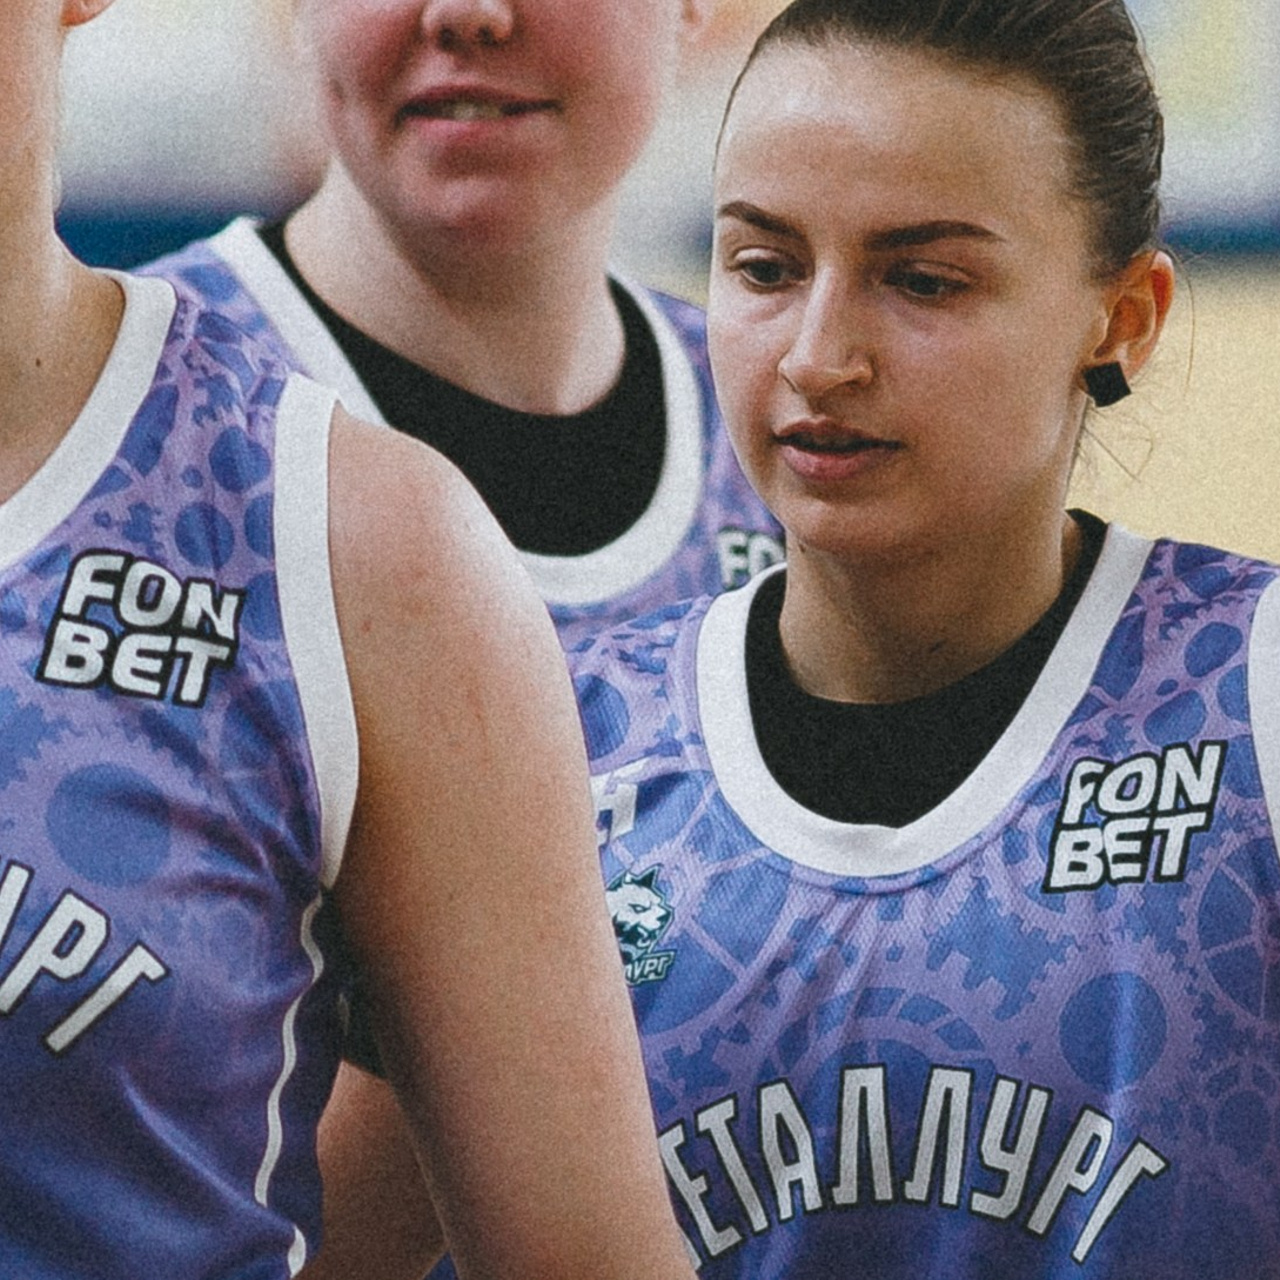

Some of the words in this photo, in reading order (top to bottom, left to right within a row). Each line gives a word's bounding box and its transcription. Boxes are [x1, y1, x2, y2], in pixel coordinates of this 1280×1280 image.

[60, 552, 241, 642] FON
[42, 617, 232, 704] BET
[1060, 743, 1223, 826] FON
[1048, 810, 1209, 889] BET
[656, 1064, 1171, 1270] ЕТАЛЛУРГ
